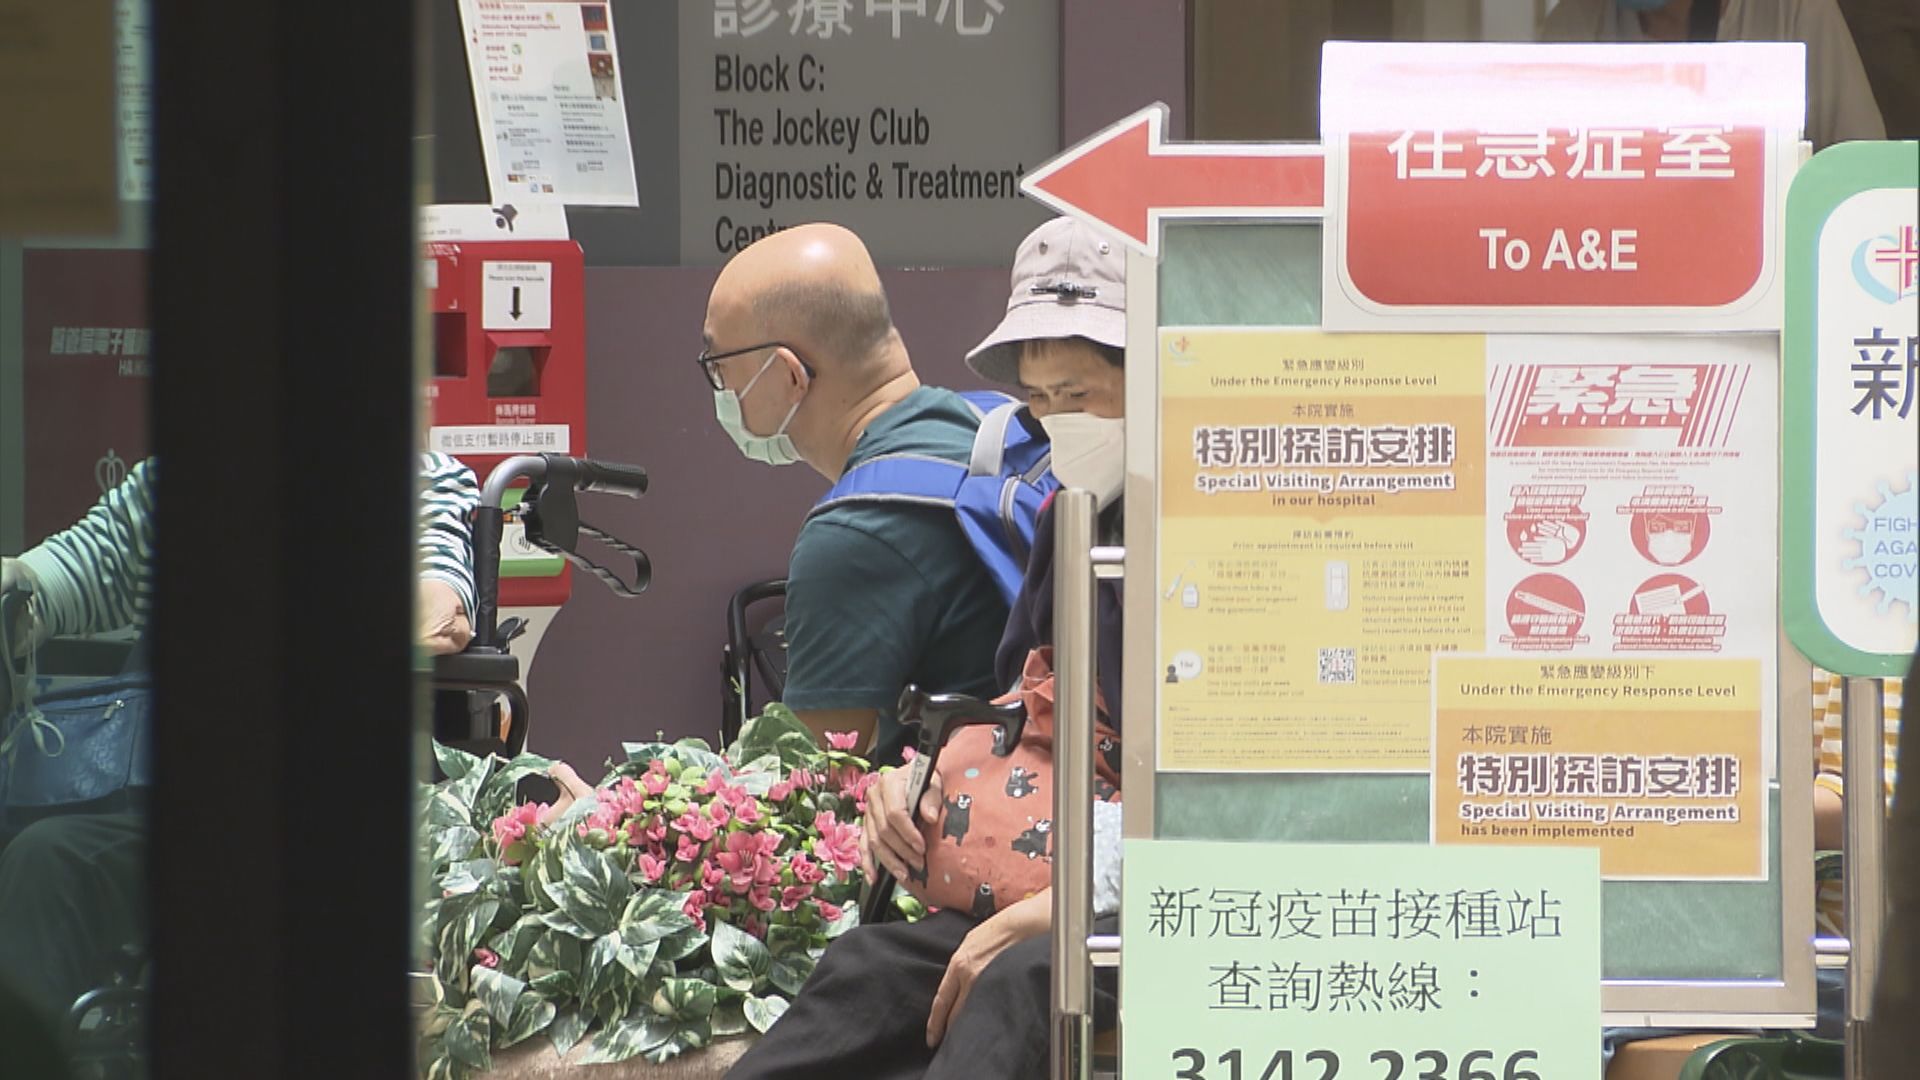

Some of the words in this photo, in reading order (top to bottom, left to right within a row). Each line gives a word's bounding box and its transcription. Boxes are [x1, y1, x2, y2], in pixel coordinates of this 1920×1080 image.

[714, 54, 790, 92] Block
[798, 54, 825, 92] C:
[713, 108, 764, 146] The
[772, 107, 860, 154] Jockey
[869, 108, 930, 146] Club
[715, 162, 857, 209] Diagnostic
[866, 162, 883, 200] &
[892, 162, 1025, 200] Treatment
[1479, 228, 1530, 270] To
[1542, 227, 1638, 271] A&E
[1282, 358, 1364, 371] 緊急應變級別
[1210, 376, 1247, 387] Under
[1250, 376, 1270, 387] the
[1273, 376, 1340, 389] Emergency
[1344, 376, 1401, 389] Response
[1405, 375, 1437, 387] Level
[1526, 366, 1698, 416] 緊急
[1292, 403, 1354, 418] 本院實施
[1196, 427, 1453, 464] 特別探訪安排
[1198, 474, 1258, 491] Special
[1267, 474, 1331, 491] Visiting
[1339, 474, 1452, 492] Arrangement
[1273, 494, 1286, 507] in
[1289, 494, 1312, 507] our
[1317, 494, 1375, 507] hospital
[1540, 665, 1656, 680] 緊急應變級別下
[1460, 684, 1505, 697] Under
[1510, 684, 1533, 697] the
[1538, 684, 1618, 699] Emergency
[1623, 685, 1693, 700] Response
[1697, 685, 1736, 698] Level
[1462, 725, 1552, 746] 本院實施
[1459, 756, 1738, 794] 特別探訪安排
[1461, 803, 1528, 820] Special
[1535, 803, 1606, 821] Visiting
[1614, 804, 1736, 822] Arrangement
[1461, 824, 1488, 839] has
[1491, 824, 1528, 839] been
[1532, 824, 1635, 839] implemented
[1148, 886, 1562, 940] 新冠疫苗接種站
[1171, 1048, 1340, 1080] 3142
